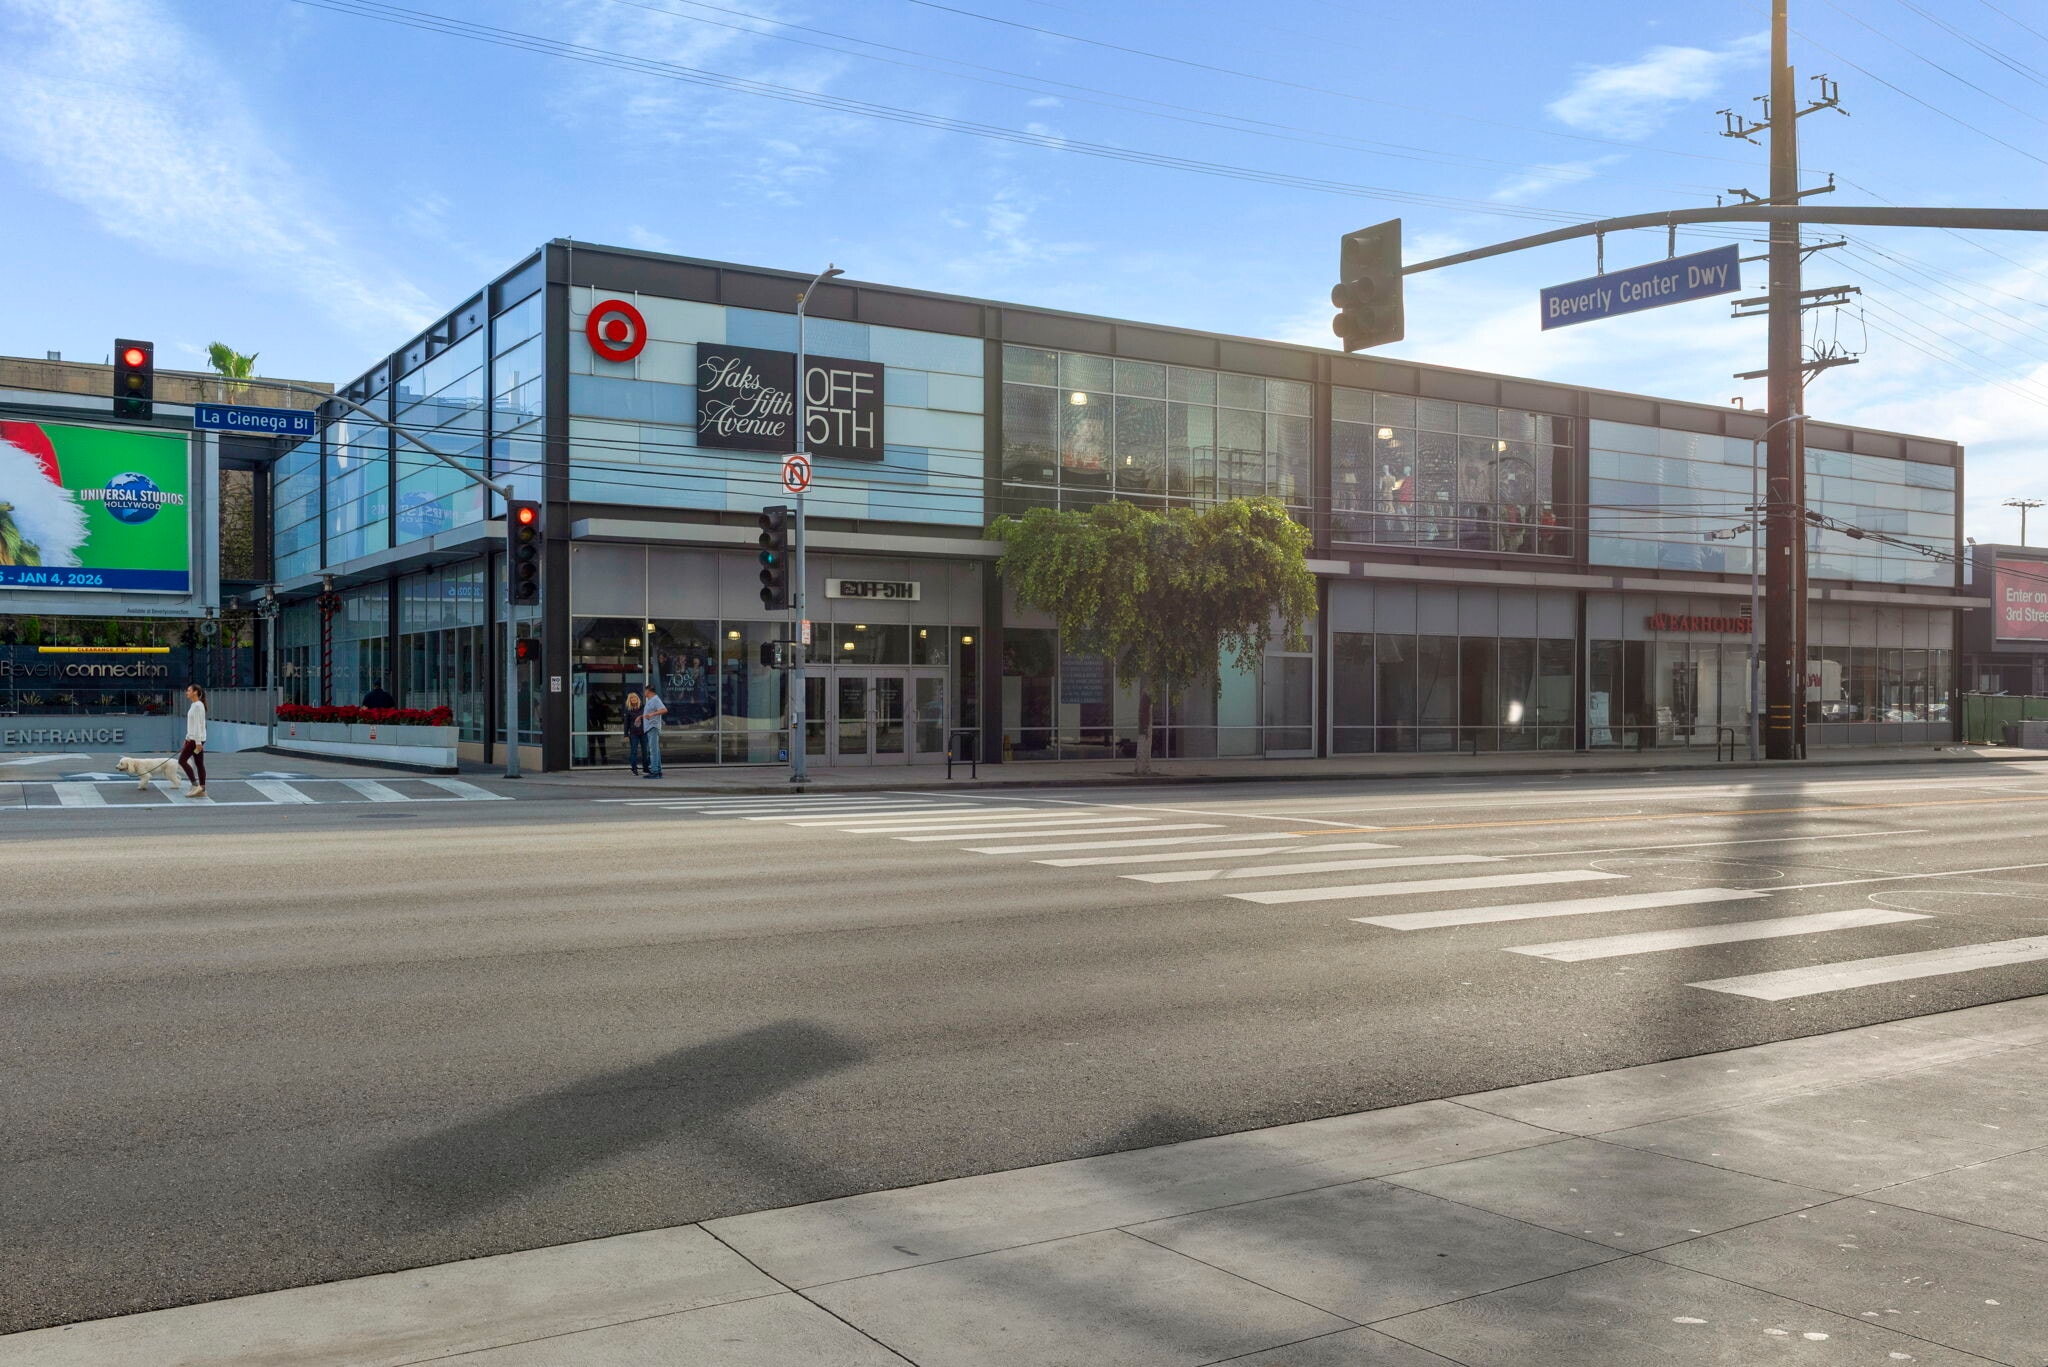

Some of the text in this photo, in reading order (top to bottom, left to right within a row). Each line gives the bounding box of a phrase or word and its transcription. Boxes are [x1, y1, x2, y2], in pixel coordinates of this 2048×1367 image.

[1550, 263, 1728, 318] Beverly Center Dwy
[698, 355, 760, 393] Saks
[805, 367, 874, 409] OFF
[202, 409, 220, 424] La
[227, 411, 287, 432] Cienega
[698, 399, 785, 437] Avenue
[805, 405, 874, 449] 5TH
[80, 488, 184, 505] UNIVERSAL STUDIOS
[104, 500, 161, 510] HOLLYWOOD
[17, 571, 47, 584] JAN
[50, 573, 64, 586] 4,
[67, 573, 103, 585] 2026
[2006, 587, 2047, 604] Enter on
[2006, 606, 2023, 621] 3rd
[666, 673, 695, 687] 70%
[4, 728, 124, 745] ENTRANCE
